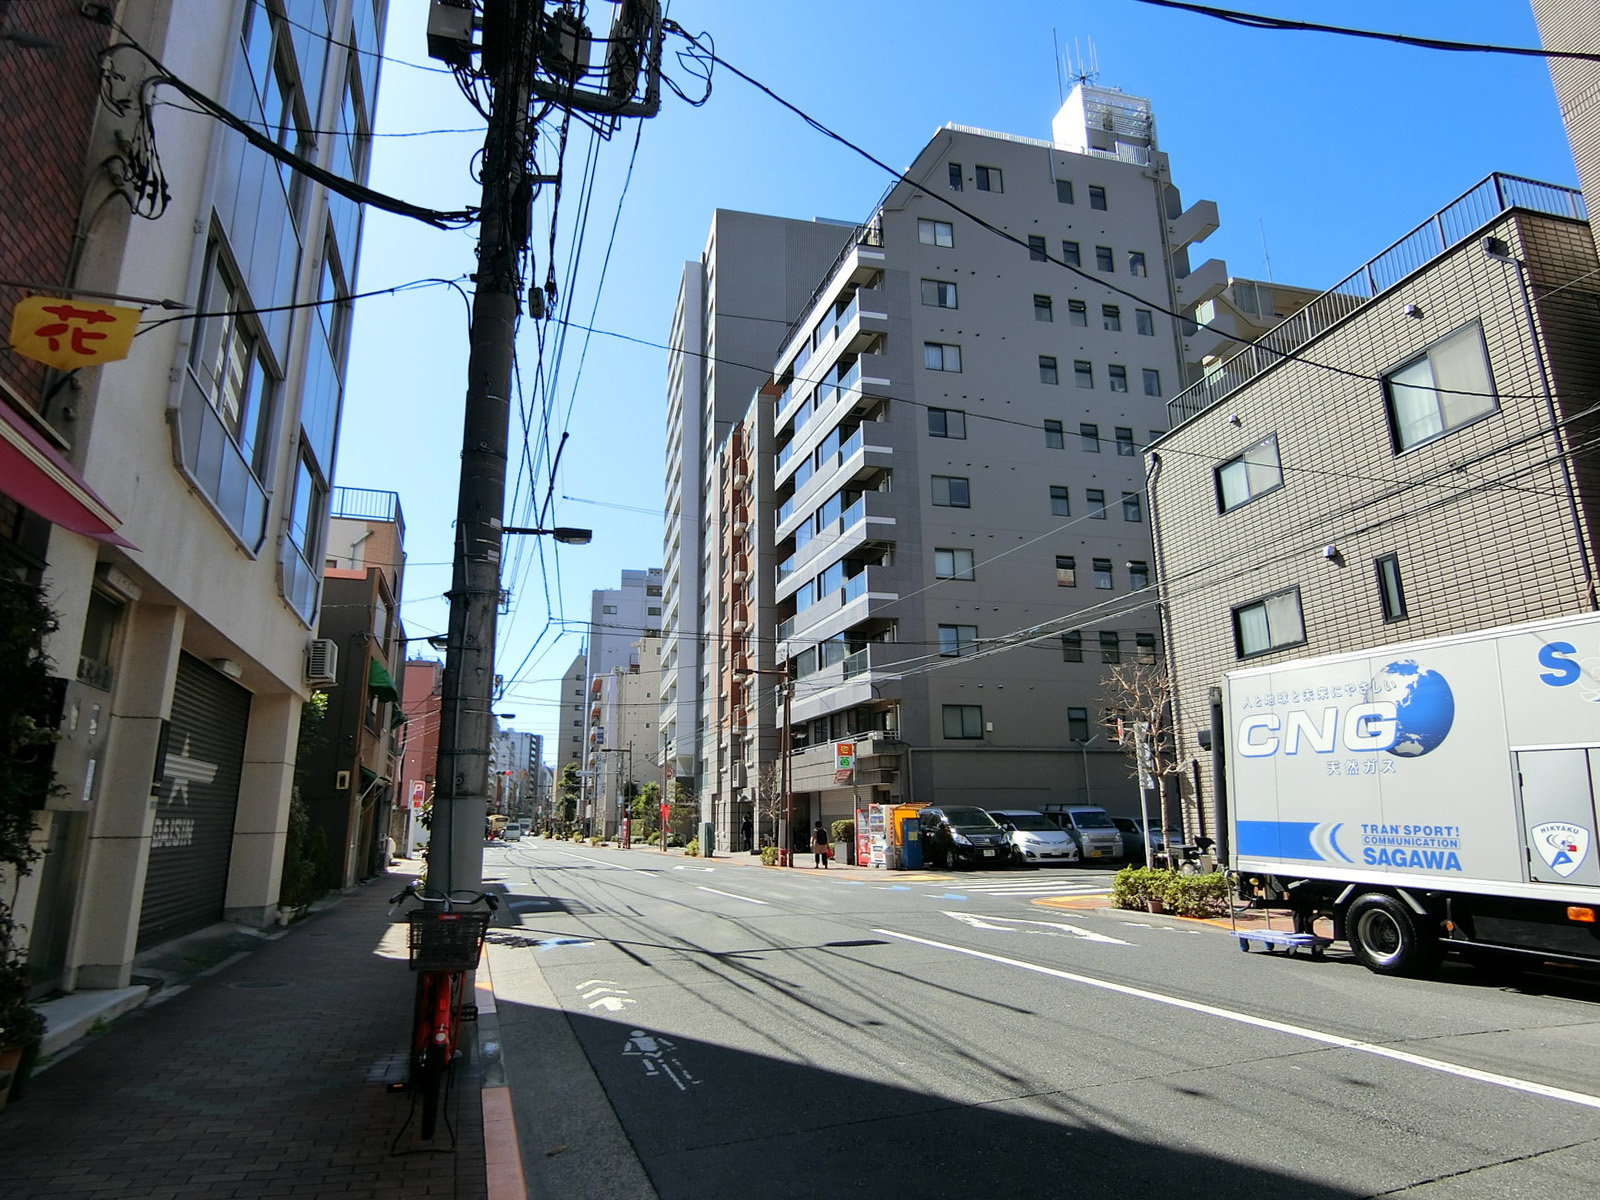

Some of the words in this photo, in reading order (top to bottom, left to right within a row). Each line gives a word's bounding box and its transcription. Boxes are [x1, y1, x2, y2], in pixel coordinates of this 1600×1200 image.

[34, 305, 117, 355] 花
[1242, 680, 1397, 710] 人と地球と未来にやさしい
[1237, 701, 1397, 758] CNG
[1326, 758, 1396, 775] 天然ガス
[1363, 836, 1458, 848] COMMUNICATION
[1540, 825, 1579, 835] HIKYAKU
[1363, 847, 1463, 872] SAGAWA
